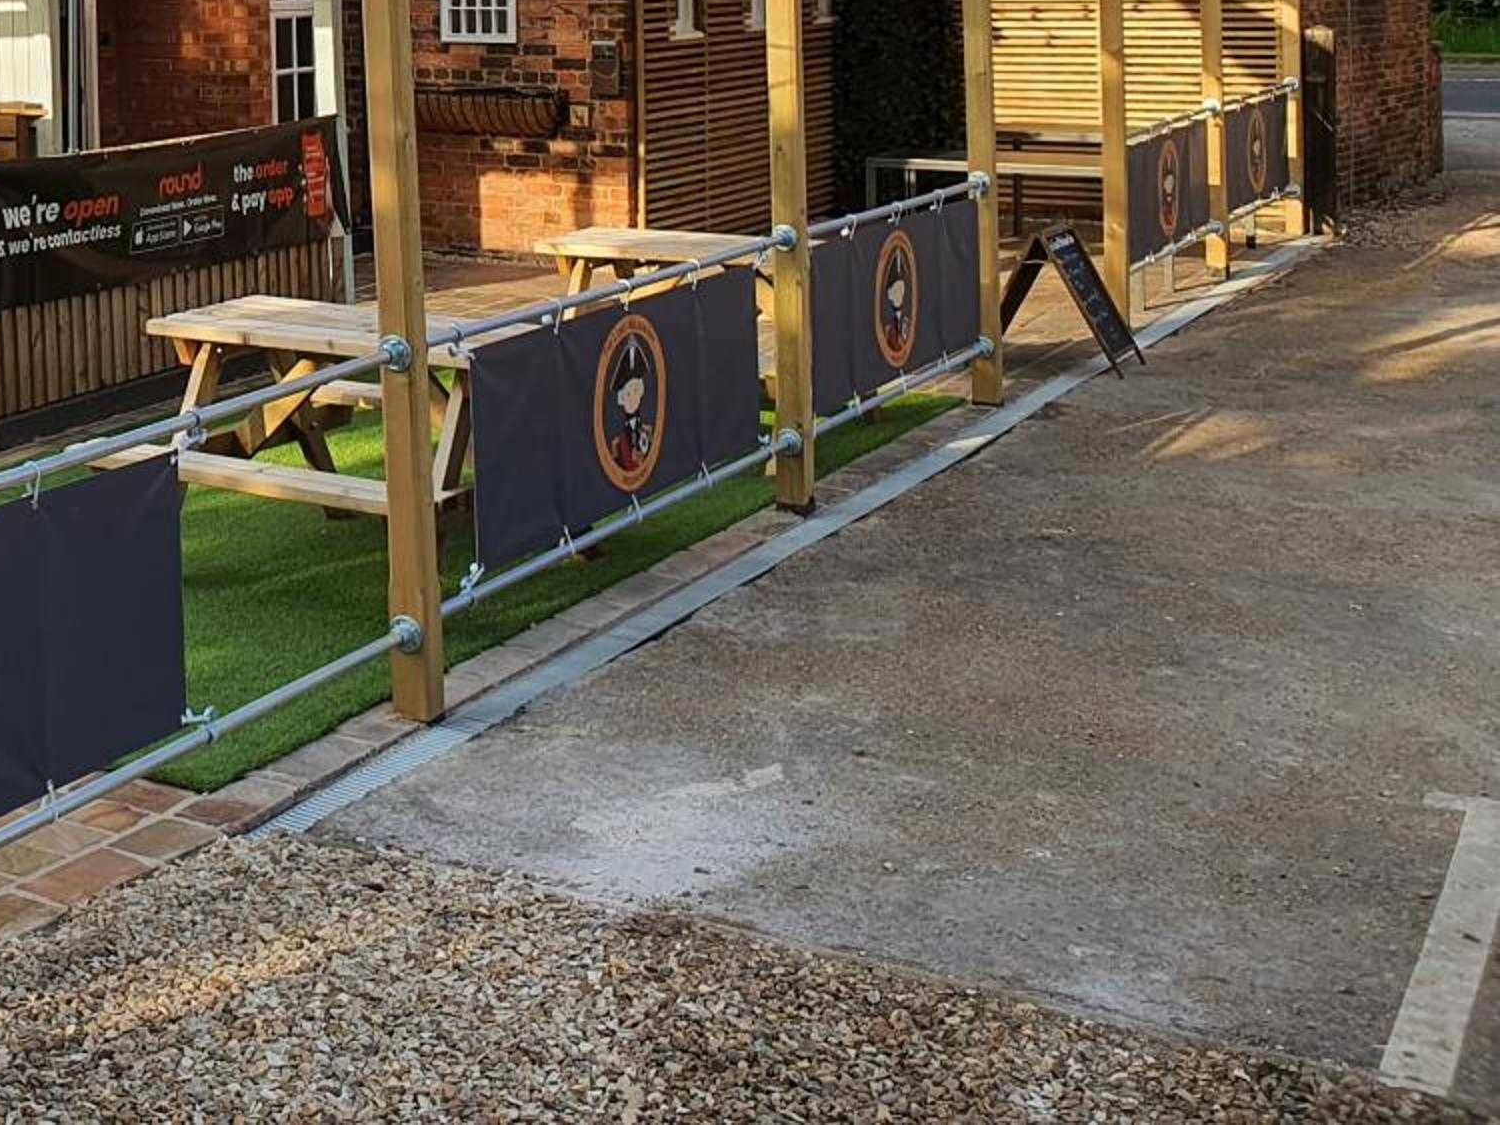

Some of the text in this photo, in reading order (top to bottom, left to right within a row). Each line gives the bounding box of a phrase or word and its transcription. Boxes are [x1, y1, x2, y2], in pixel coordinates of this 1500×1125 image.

[159, 161, 203, 196] round
[233, 159, 288, 183] the order
[2, 194, 120, 230] we're open
[231, 186, 293, 216] & pay app
[7, 232, 47, 256] we're
[47, 224, 121, 248] contactless
